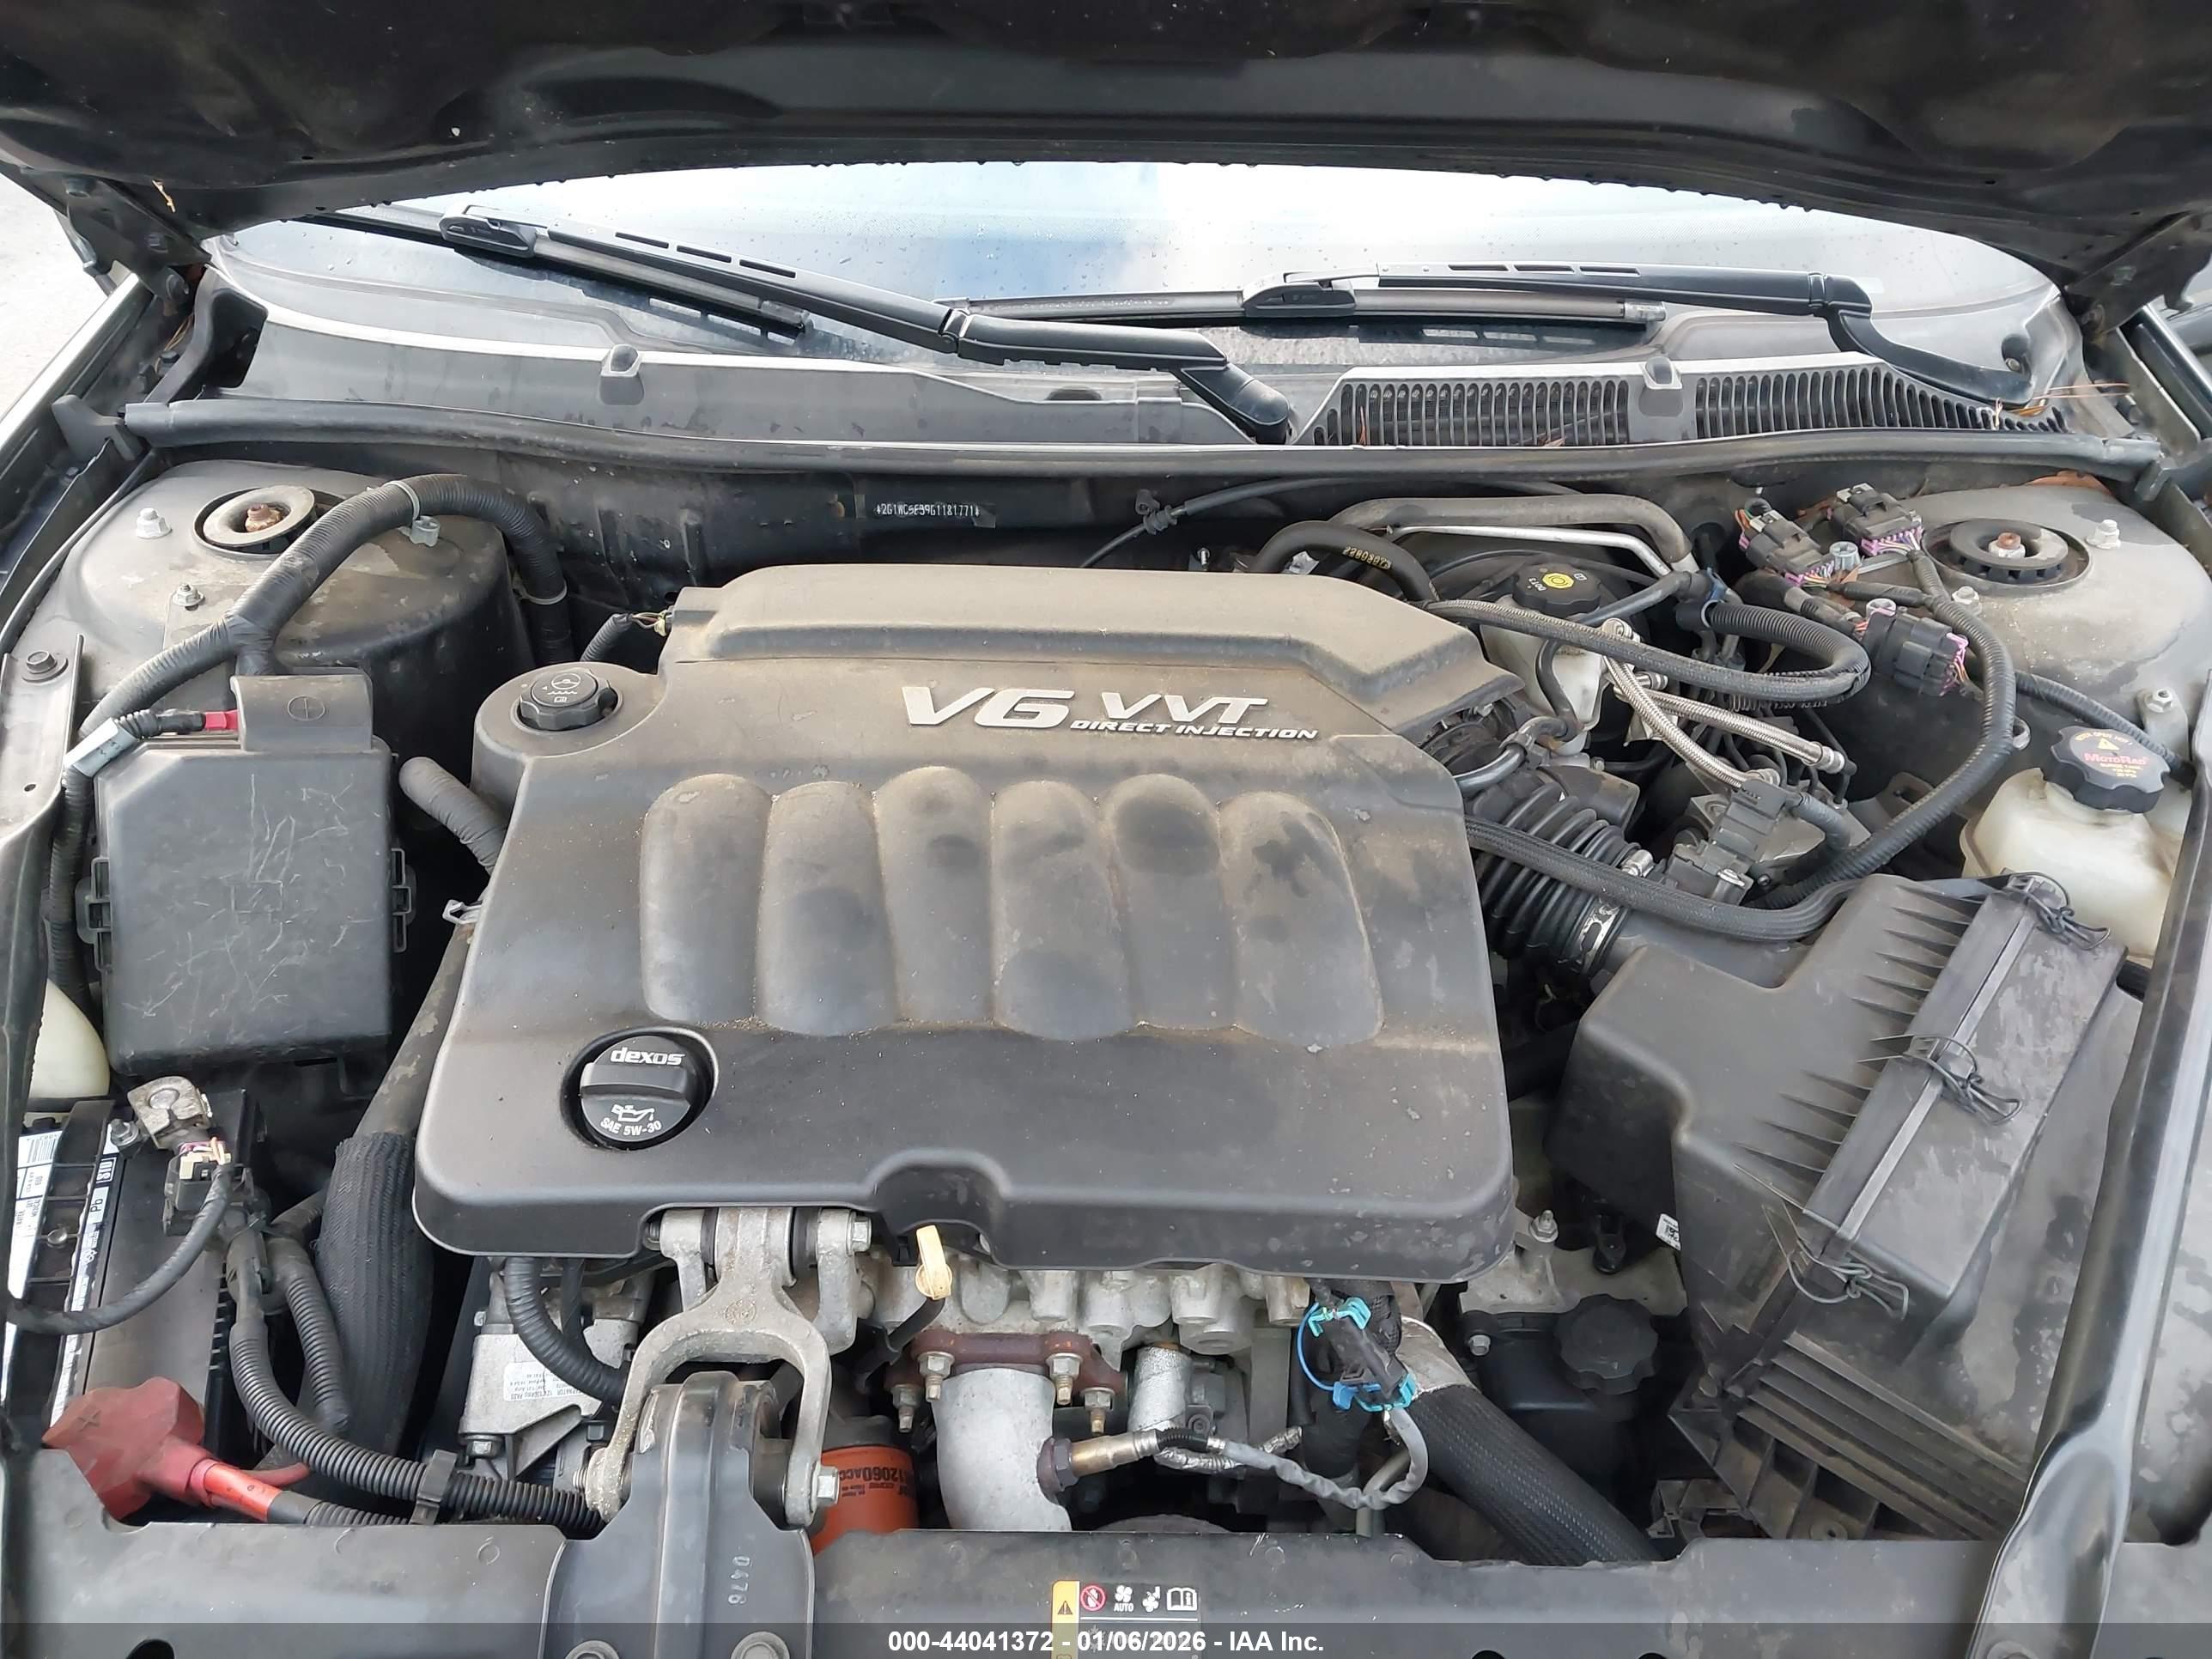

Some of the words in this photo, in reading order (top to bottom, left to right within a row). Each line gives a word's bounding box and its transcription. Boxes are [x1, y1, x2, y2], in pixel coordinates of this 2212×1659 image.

[902, 687, 1075, 729] V6
[1102, 692, 1269, 724] VVT
[1070, 720, 1172, 733] DIRECT
[1175, 725, 1319, 740] INJECTION
[611, 1047, 686, 1066] dexos
[600, 1117, 620, 1134] SAE
[623, 1120, 662, 1136] 5W-30
[90, 1198, 104, 1212] Pb
[1114, 1603, 1134, 1613] AUTO
